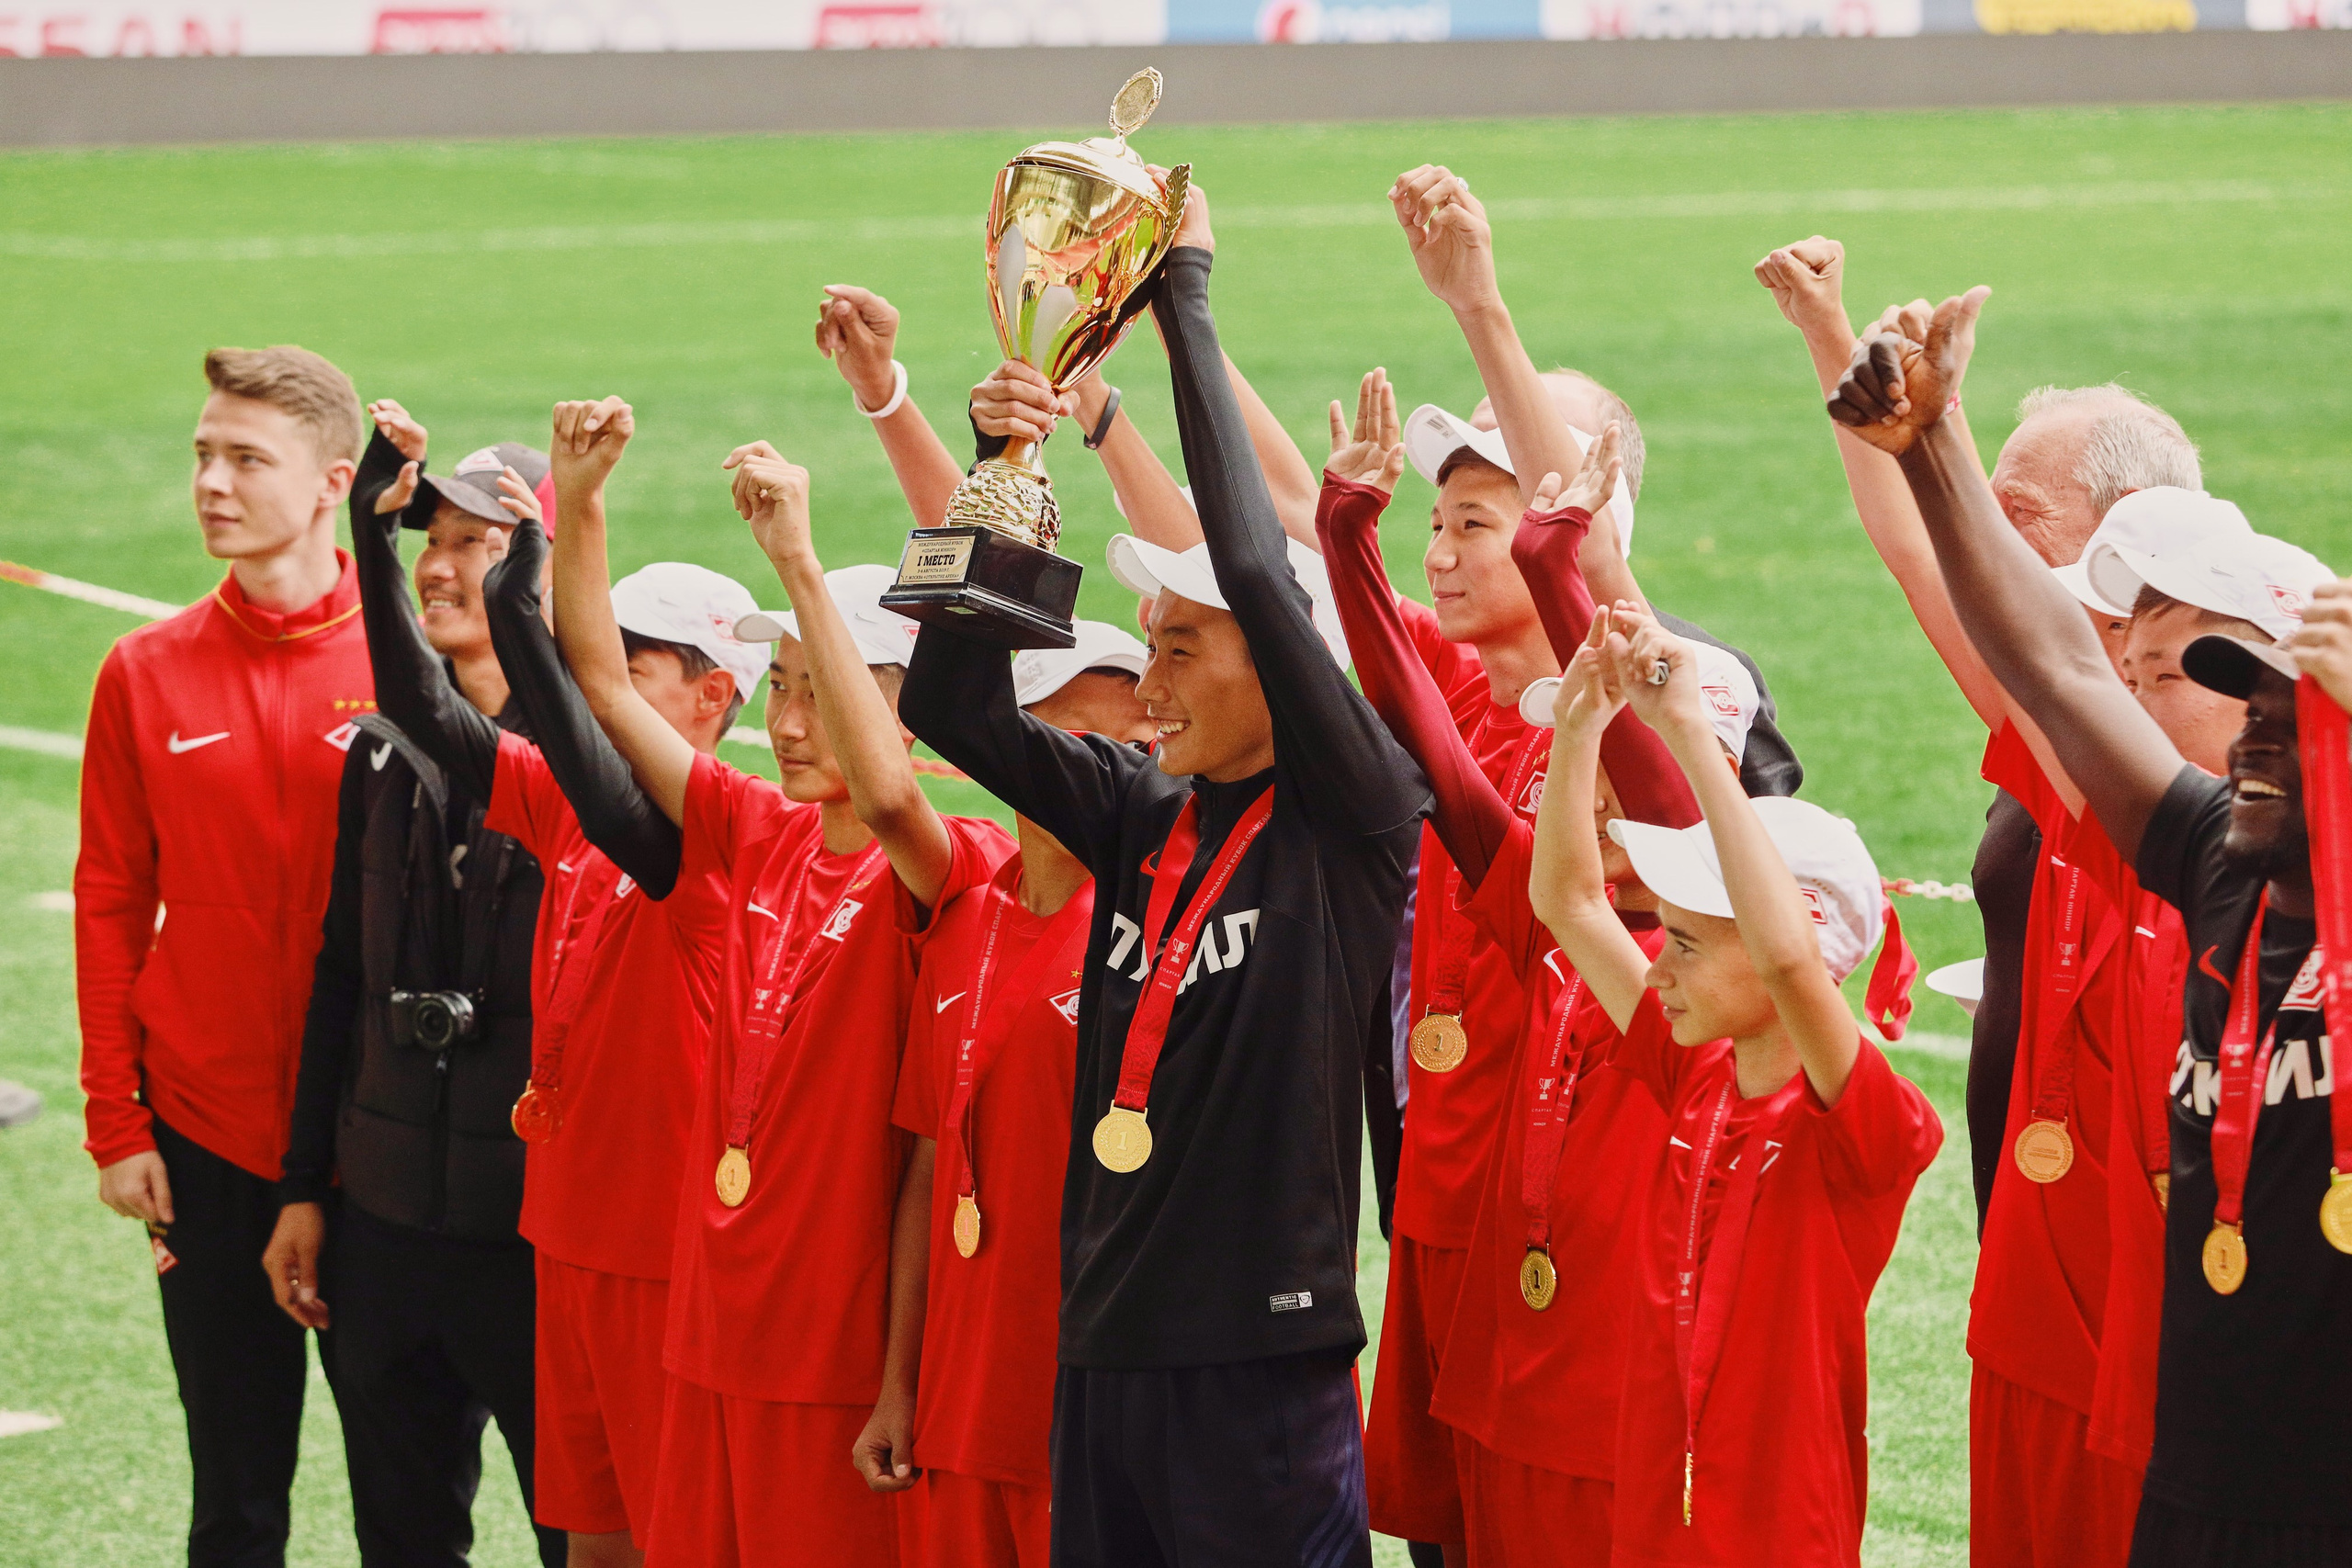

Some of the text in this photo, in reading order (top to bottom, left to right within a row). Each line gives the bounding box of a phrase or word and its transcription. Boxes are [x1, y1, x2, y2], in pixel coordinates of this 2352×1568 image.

[923, 554, 956, 567] МЕСТО
[1528, 727, 1546, 751] СПАРТ
[1187, 863, 1232, 931] МЕЖДУНАРОДНЫЙ
[1229, 840, 1248, 864] КУБОК
[1245, 812, 1272, 840] СПАРТАК
[2068, 867, 2079, 899] ПАРТАК
[986, 931, 997, 956] КУБОК
[1159, 966, 1181, 978] СПАРТАК
[1551, 994, 1575, 1066] МЕЖДУНАРОДНЫЙ
[1571, 973, 1581, 997] КУБО
[1434, 1032, 1443, 1052] 1
[1117, 1131, 1128, 1151] 1
[1534, 1269, 1542, 1289] 1
[1272, 1294, 1297, 1303] AUTHENTIC
[1272, 1303, 1299, 1311] FOOTBALL
